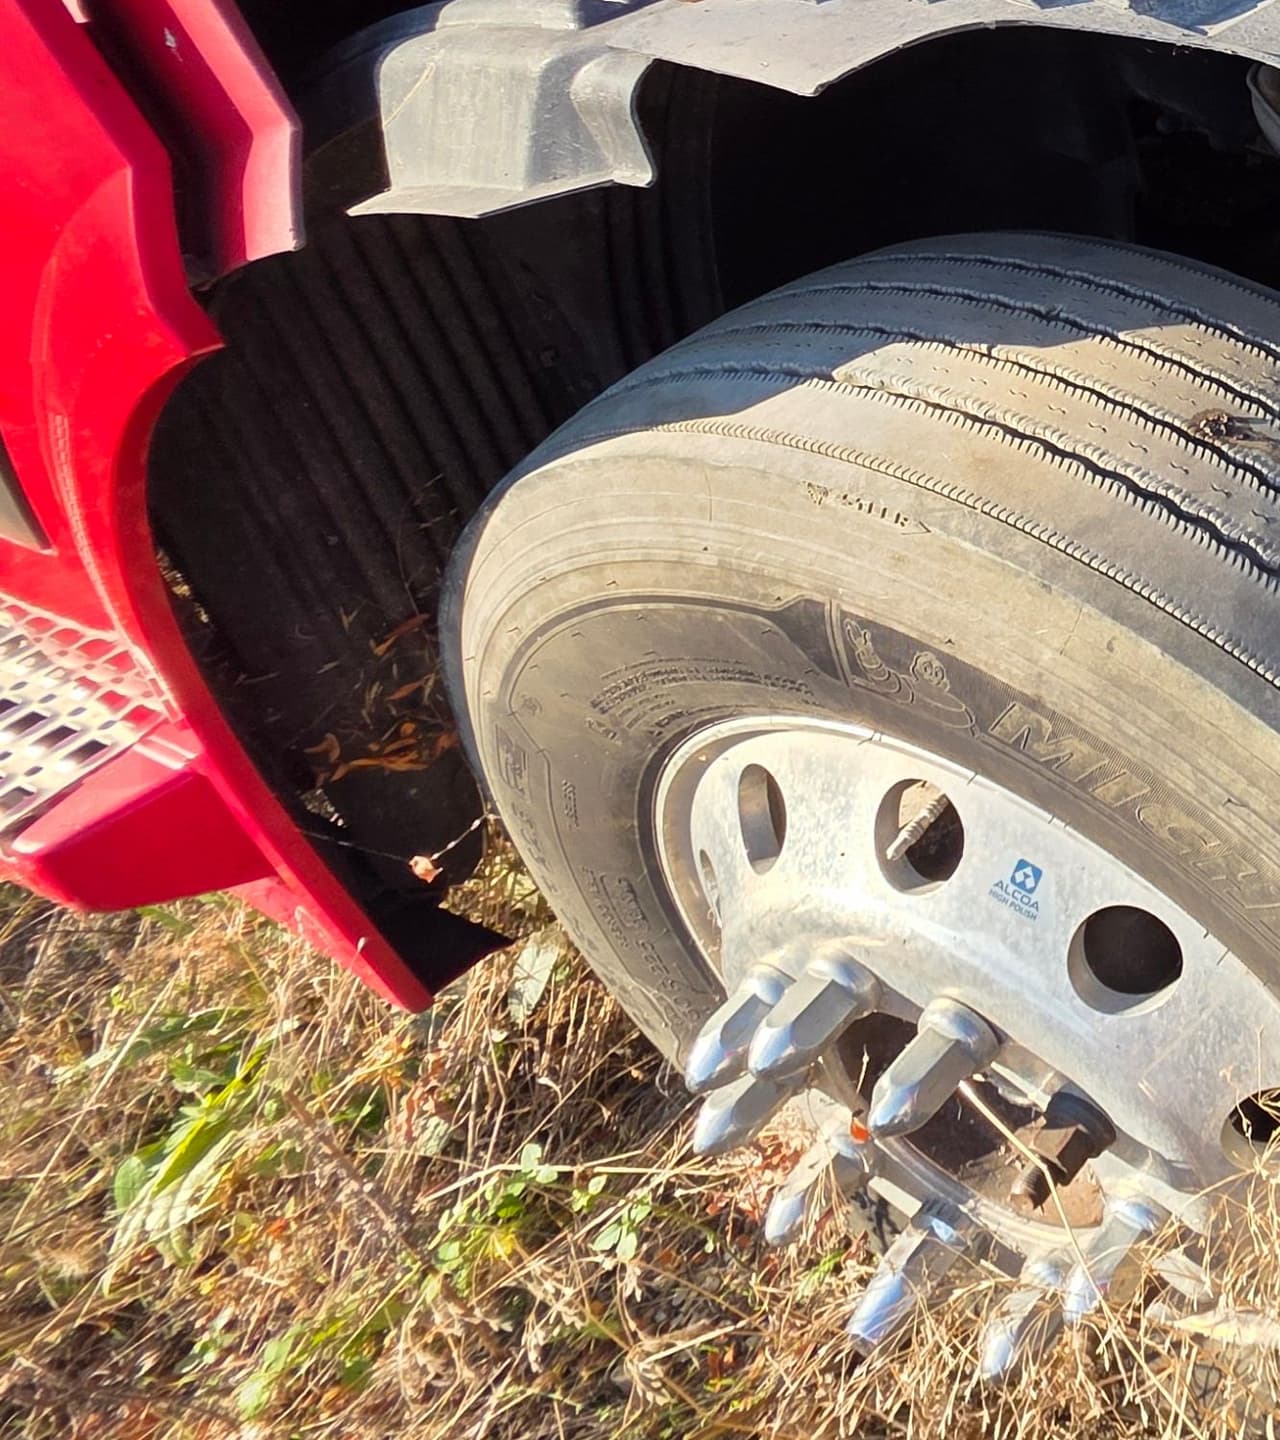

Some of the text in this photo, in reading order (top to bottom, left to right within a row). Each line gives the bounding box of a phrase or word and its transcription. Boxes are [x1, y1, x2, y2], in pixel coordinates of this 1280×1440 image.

[988, 889, 1038, 921] HIGH POLISH
[992, 880, 1040, 913] ALCOA
